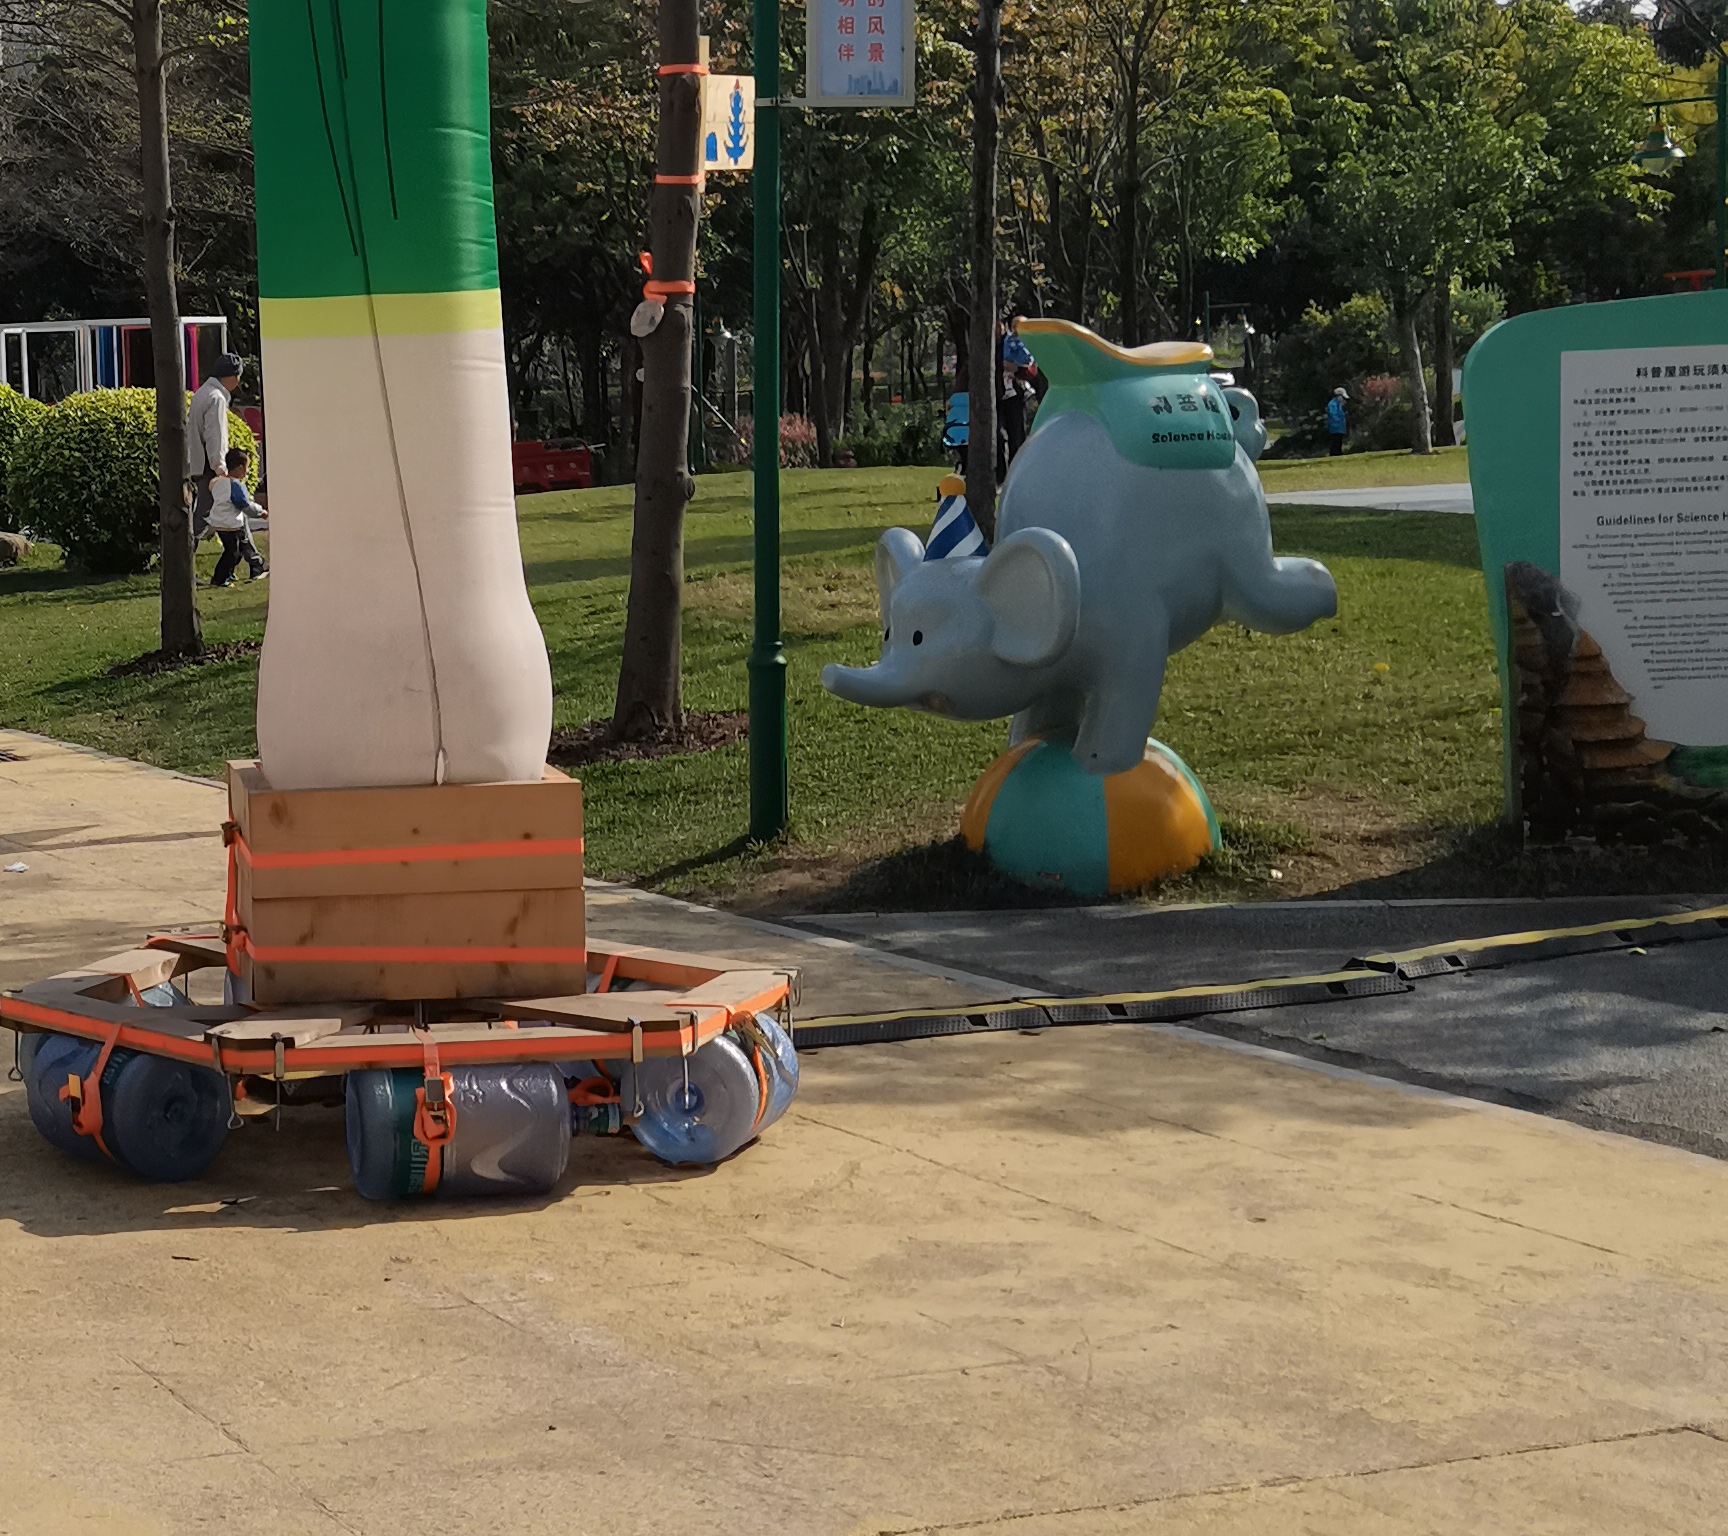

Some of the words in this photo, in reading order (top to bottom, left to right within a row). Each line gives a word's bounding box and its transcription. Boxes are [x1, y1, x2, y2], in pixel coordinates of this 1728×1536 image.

[1596, 515, 1656, 527] Guidelines
[1658, 513, 1674, 524] for
[1677, 512, 1720, 524] Science
